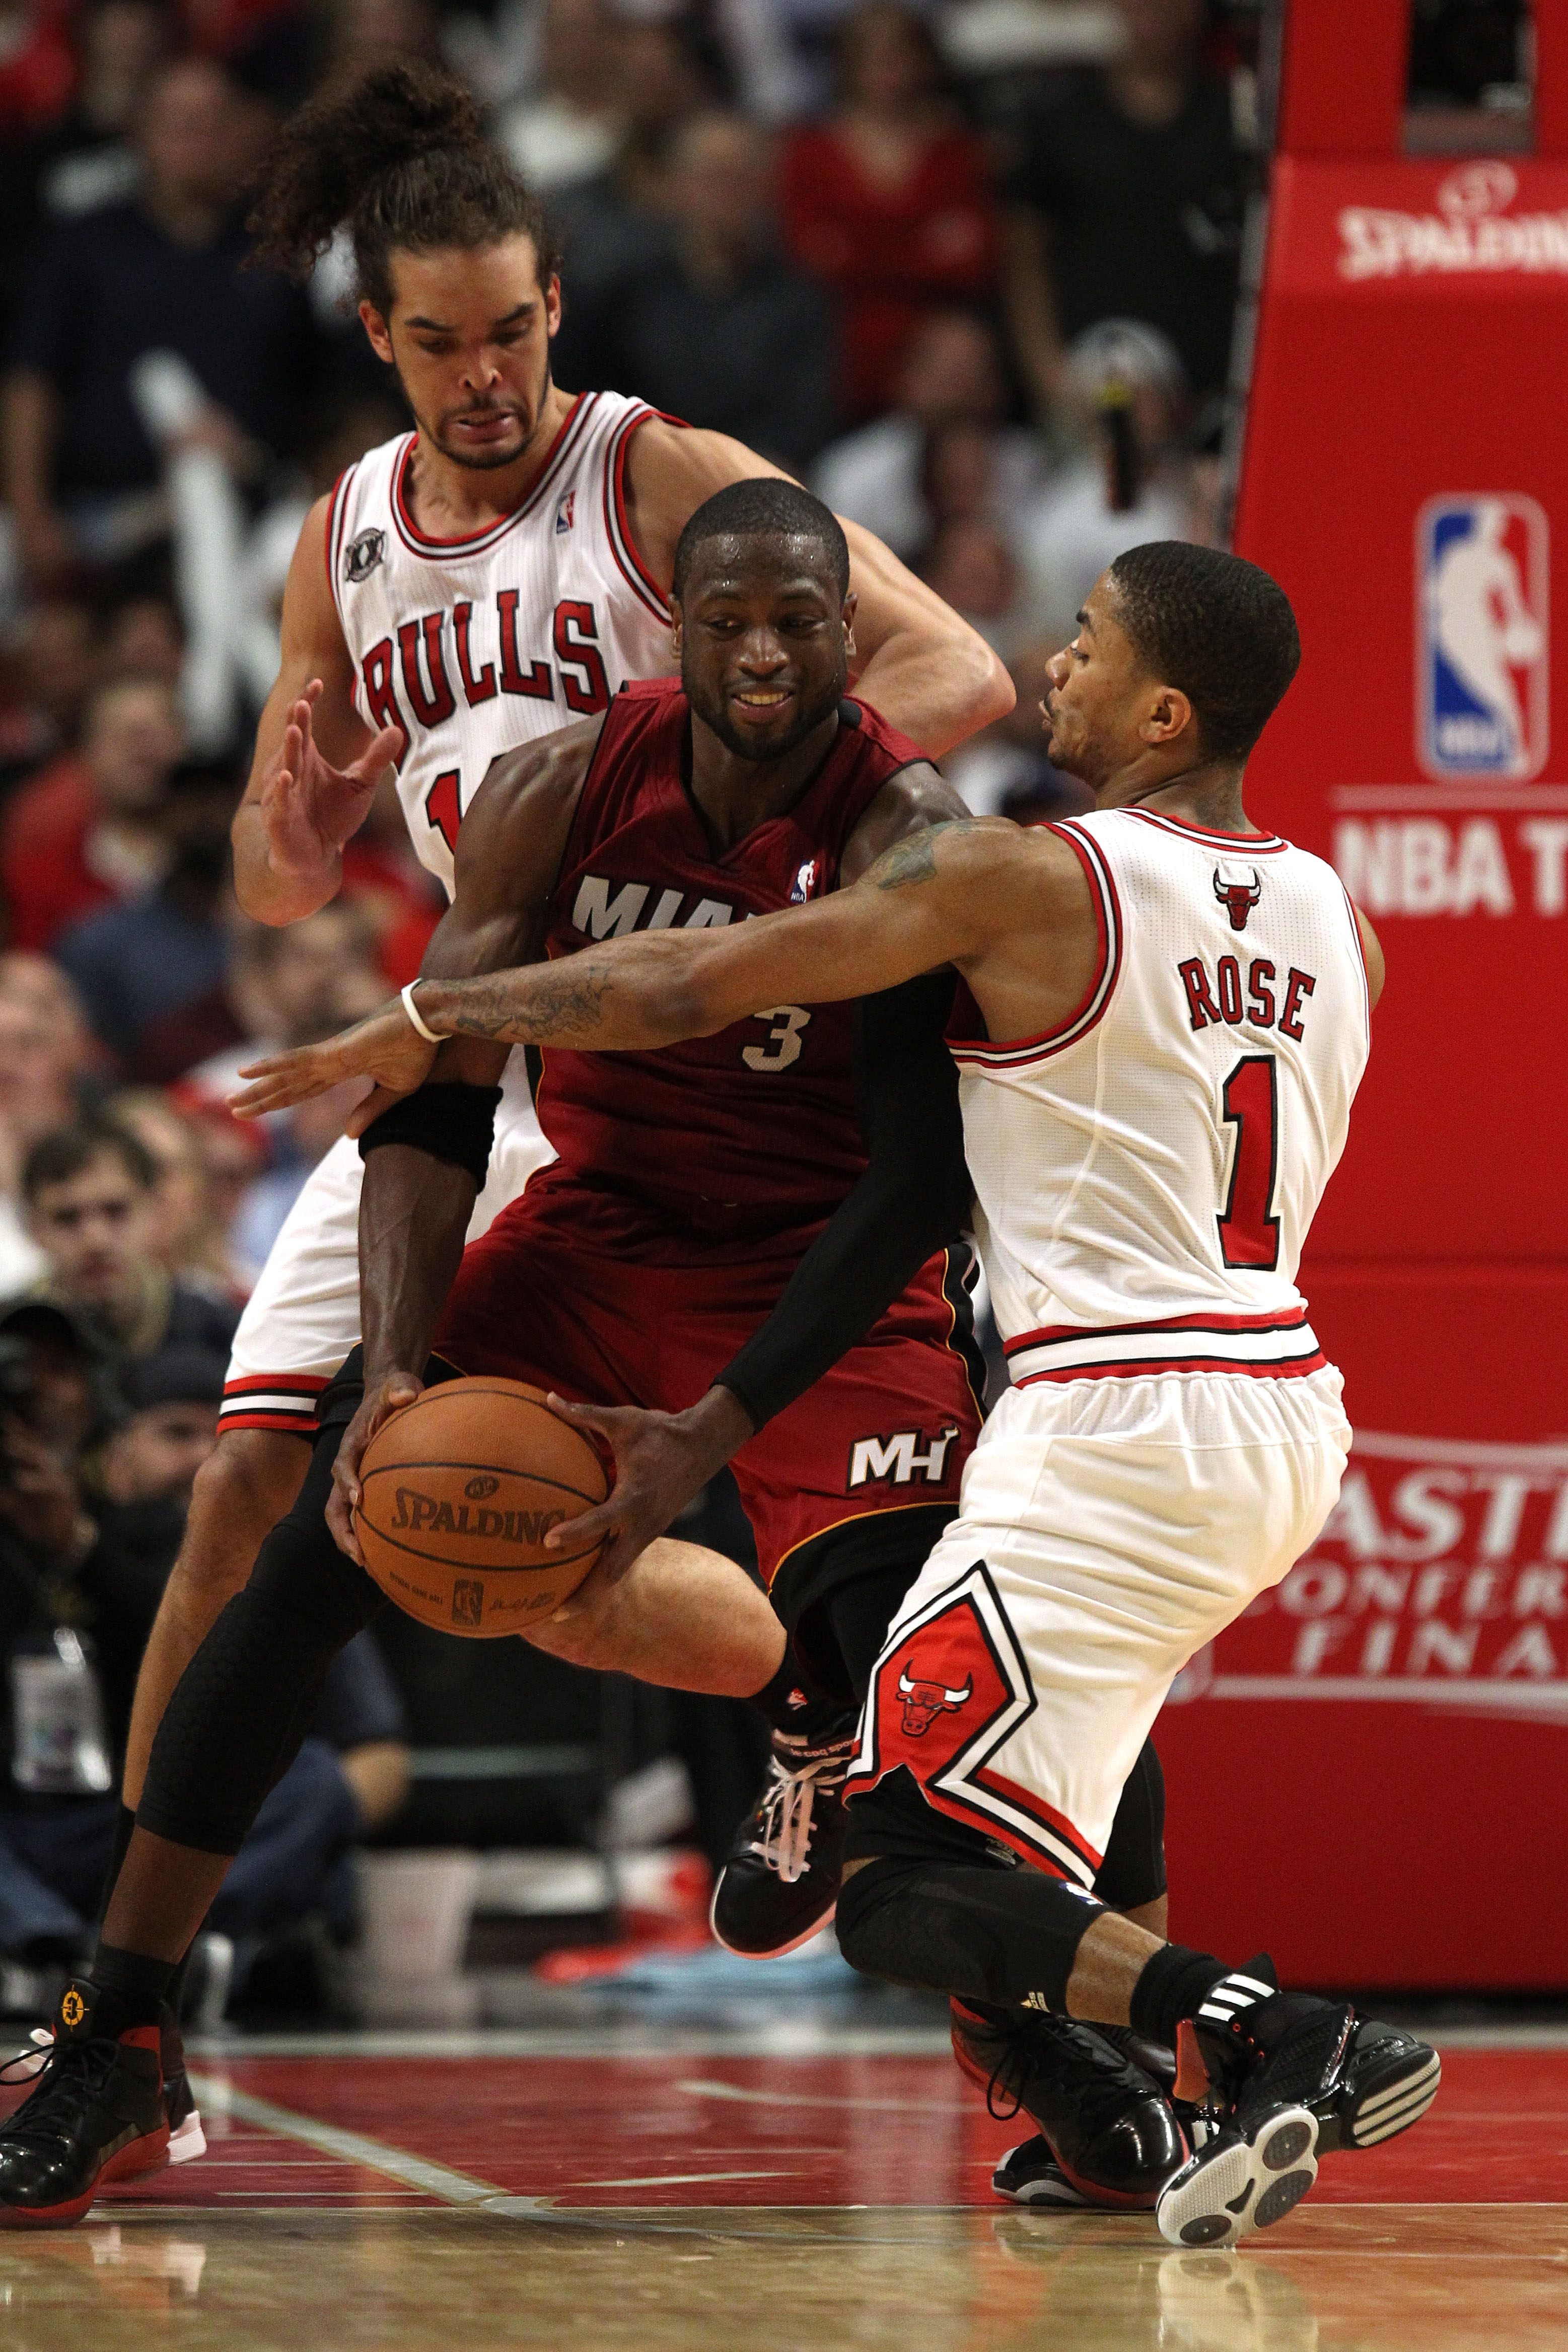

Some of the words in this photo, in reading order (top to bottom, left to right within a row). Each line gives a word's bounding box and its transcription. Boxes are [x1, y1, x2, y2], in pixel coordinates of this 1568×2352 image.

[362, 588, 609, 775] BULLS
[572, 875, 761, 940] MIA
[1337, 818, 1514, 915] NBA
[742, 1006, 811, 1072] 3
[1178, 955, 1316, 1042] ROSE
[1216, 1054, 1281, 1271] 1
